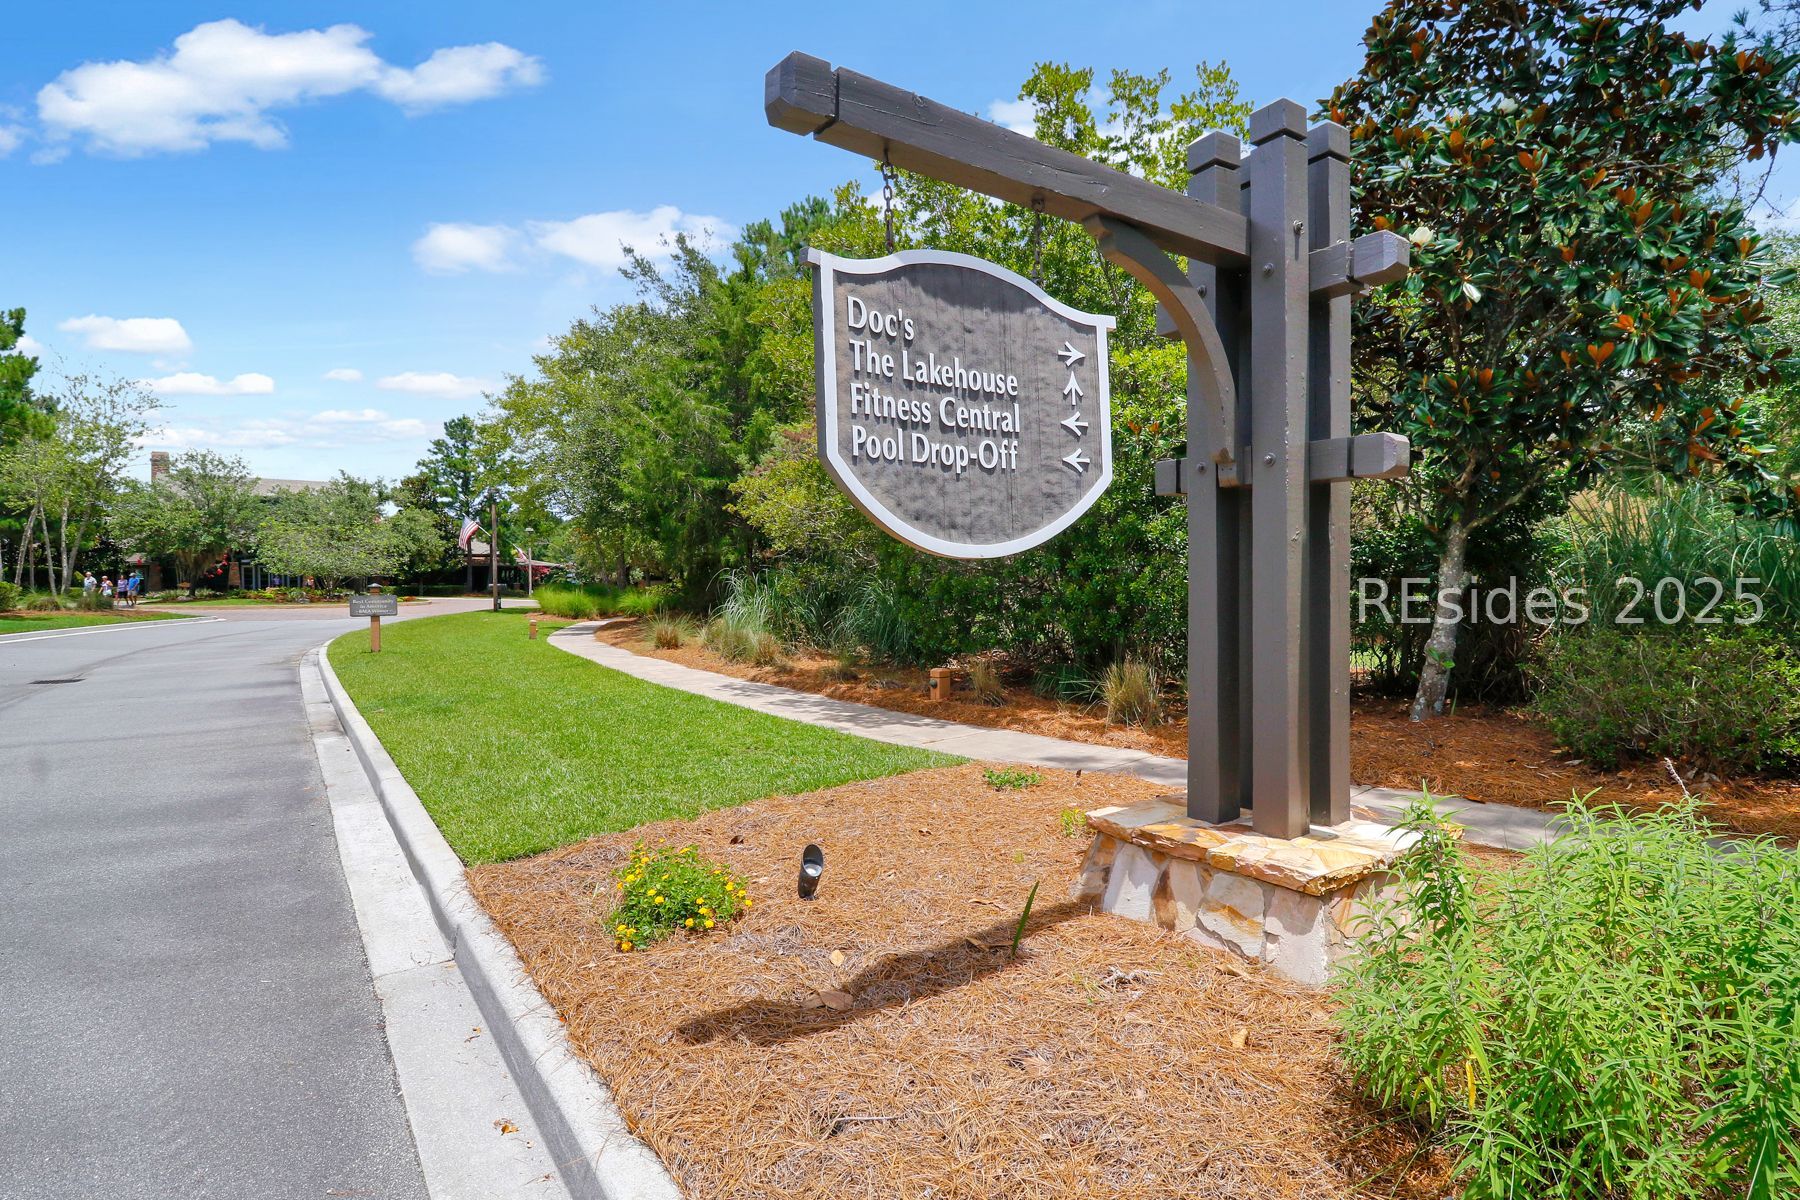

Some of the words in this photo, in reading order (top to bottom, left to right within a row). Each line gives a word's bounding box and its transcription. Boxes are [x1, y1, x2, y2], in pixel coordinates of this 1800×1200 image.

[847, 296, 914, 341] Doc's
[849, 339, 894, 378] The
[902, 350, 1018, 396] Lakehouse
[850, 382, 932, 424] Fitness
[940, 396, 1020, 433] Central
[852, 425, 903, 461] Pool
[912, 432, 1018, 474] Drop-Off
